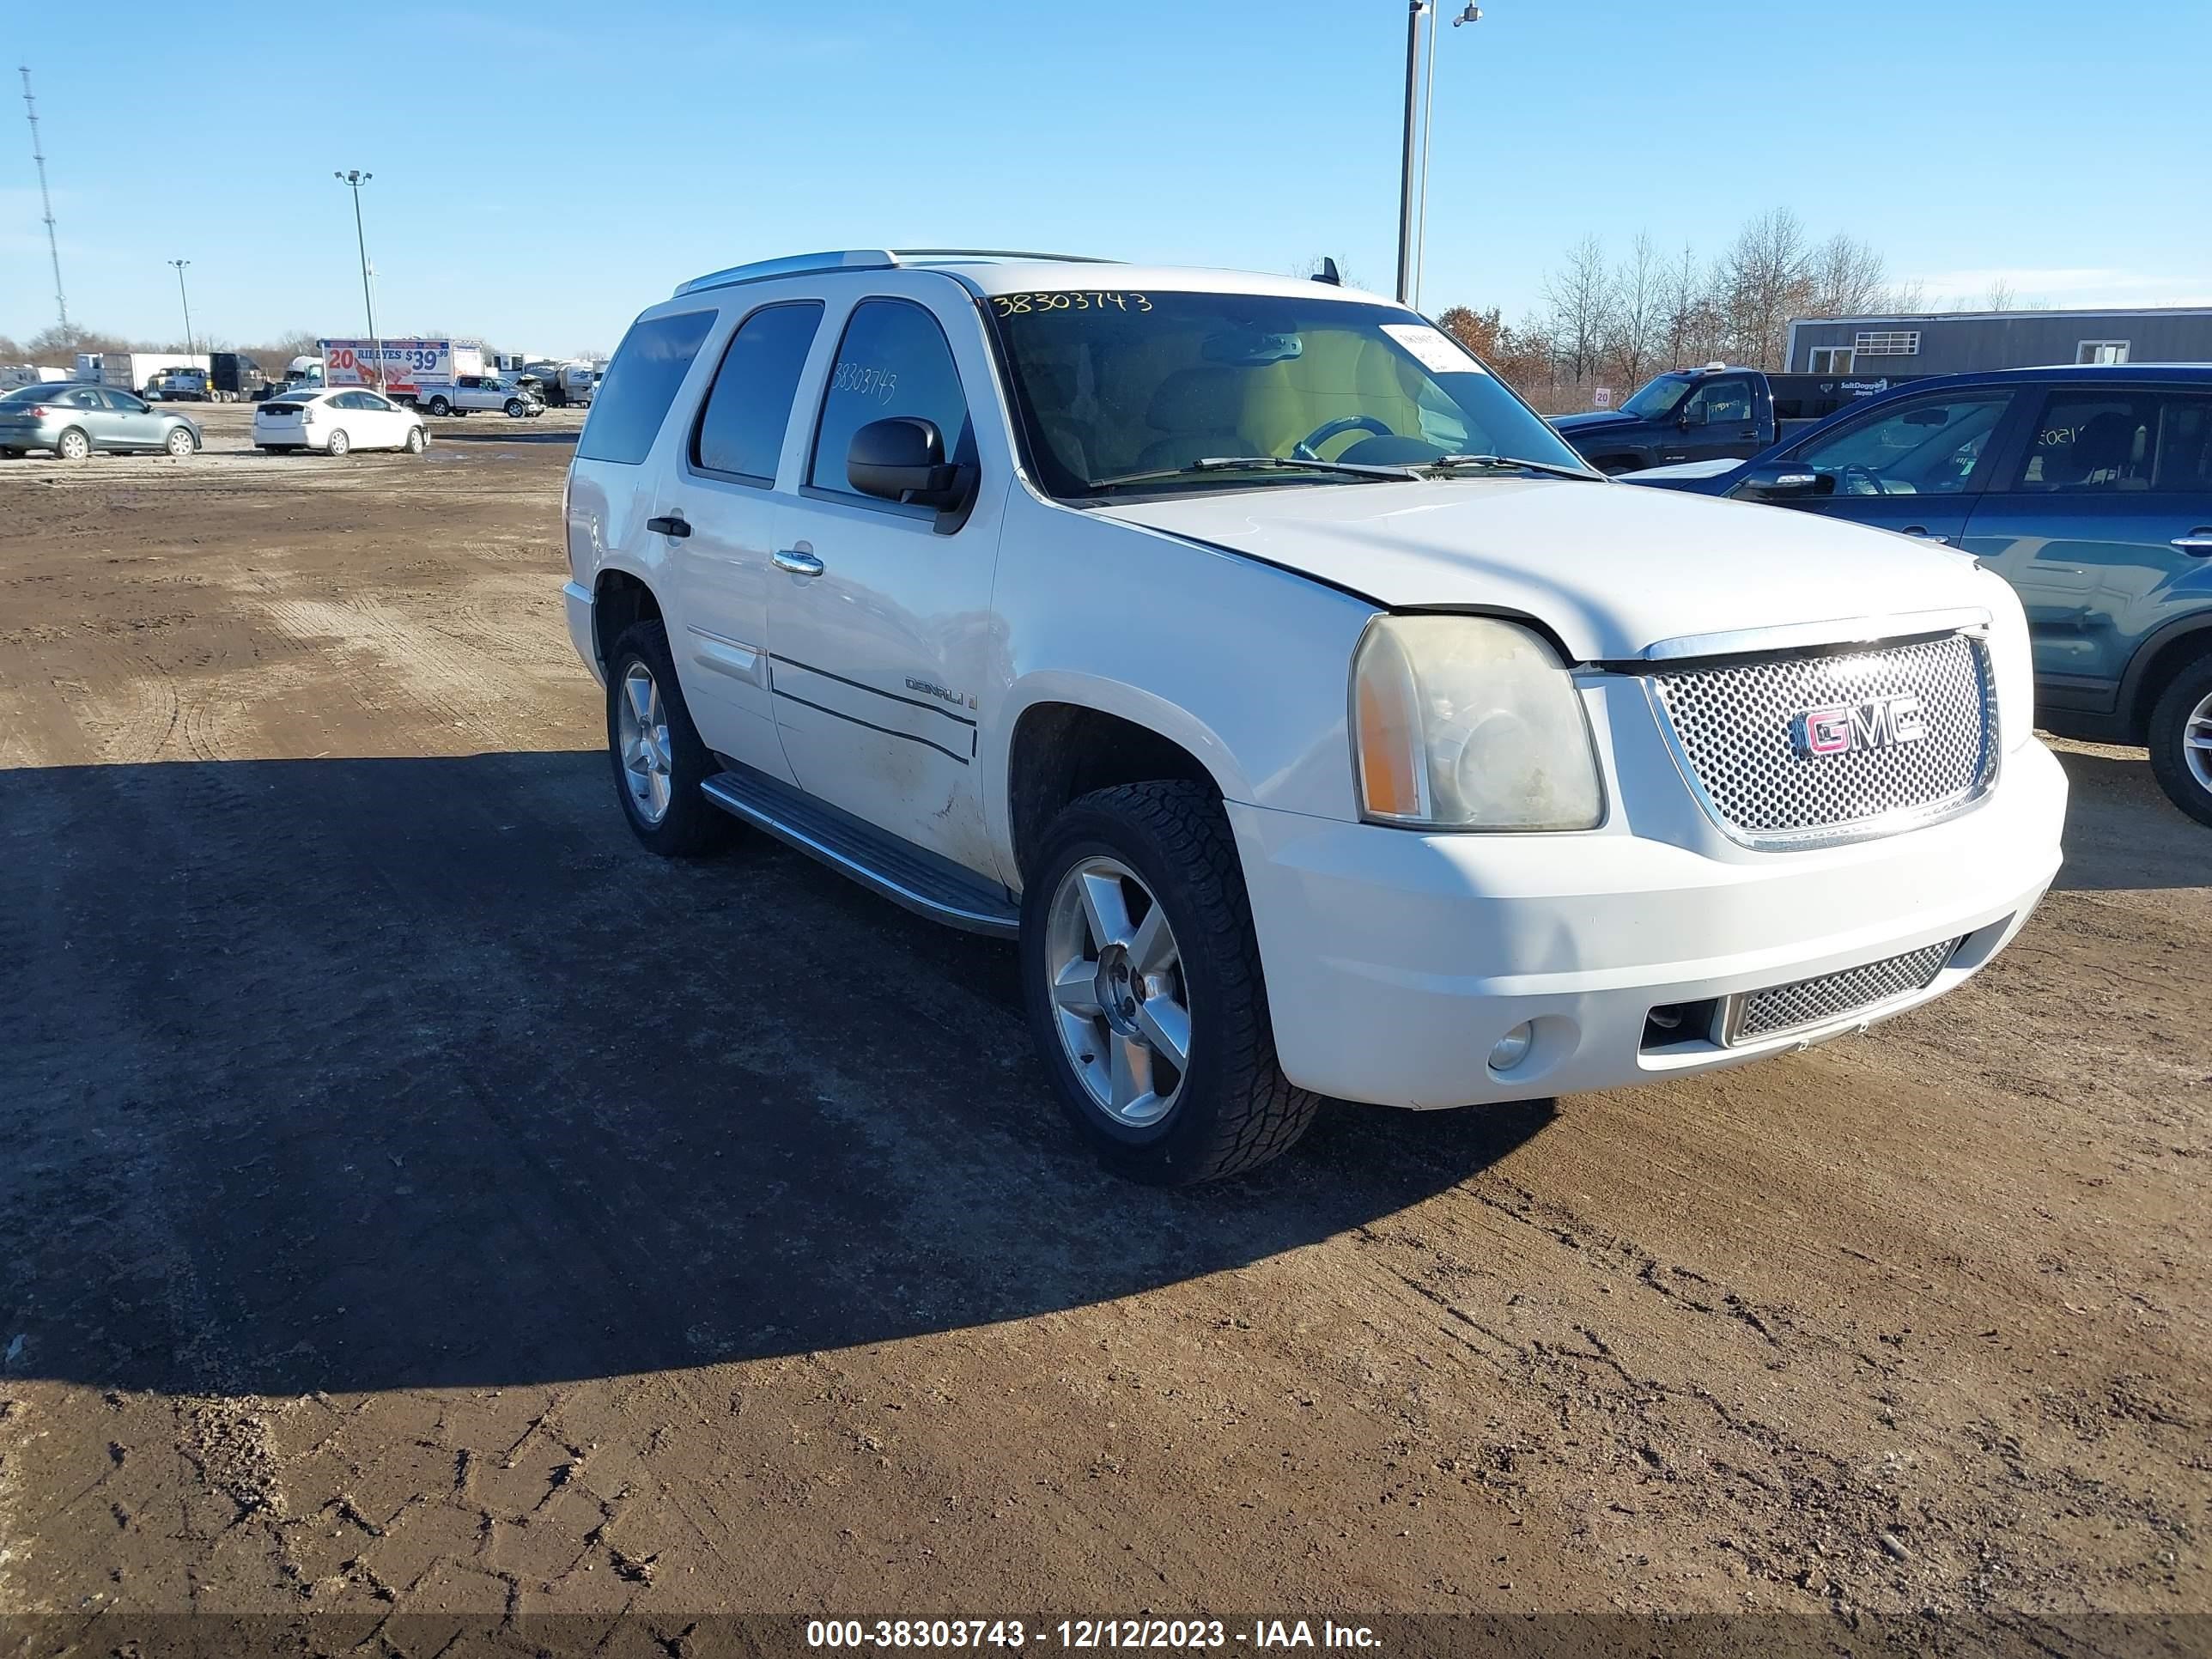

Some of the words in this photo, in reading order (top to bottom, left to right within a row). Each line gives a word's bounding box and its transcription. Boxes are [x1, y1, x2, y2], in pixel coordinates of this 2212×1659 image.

[994, 293, 1153, 317] 38303743
[329, 349, 354, 368] 20
[832, 362, 896, 405] 38303743
[1597, 392, 1607, 402] 20
[905, 677, 963, 705] DENALI
[1805, 697, 1927, 755] GMC
